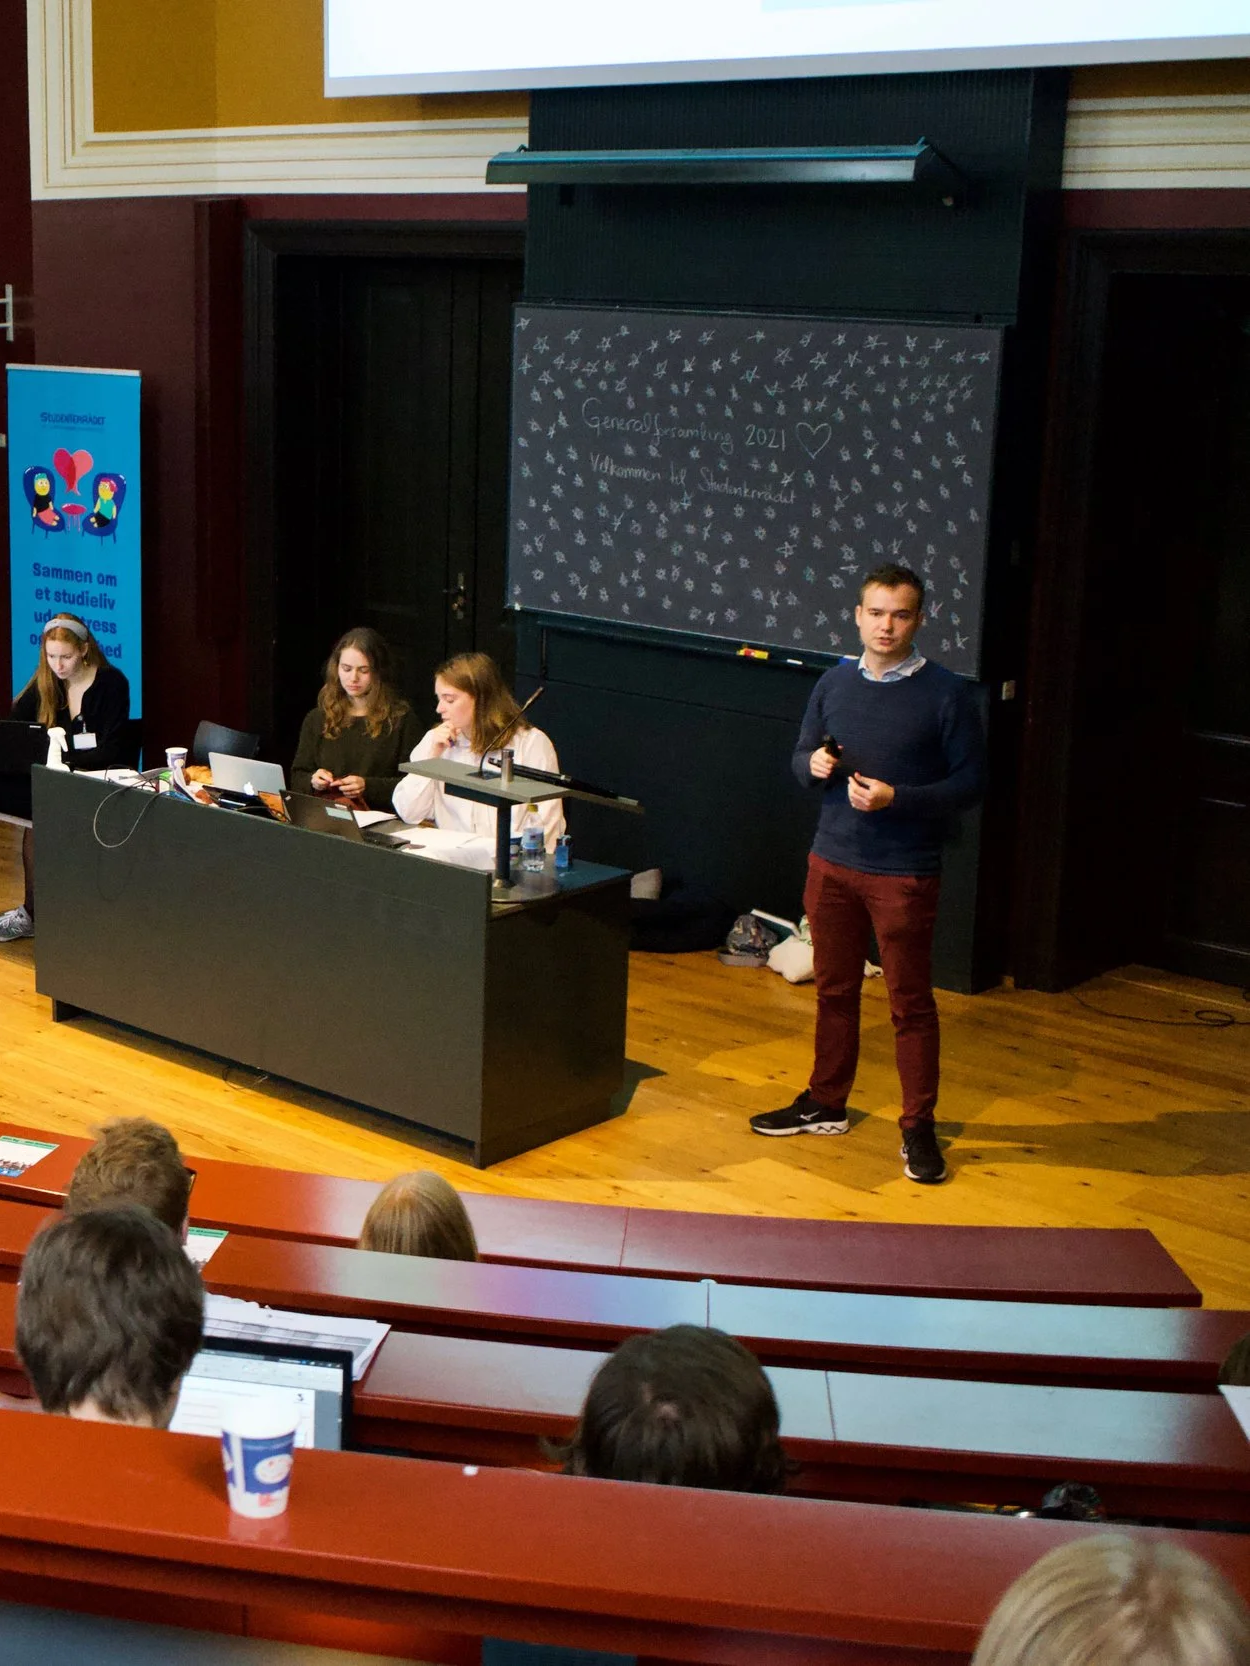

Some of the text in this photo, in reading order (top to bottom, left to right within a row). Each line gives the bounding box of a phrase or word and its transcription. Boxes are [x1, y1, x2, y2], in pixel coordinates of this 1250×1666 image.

[745, 424, 786, 451] 2021
[32, 562, 118, 587] Sammen om
[35, 587, 116, 611] et studieliv
